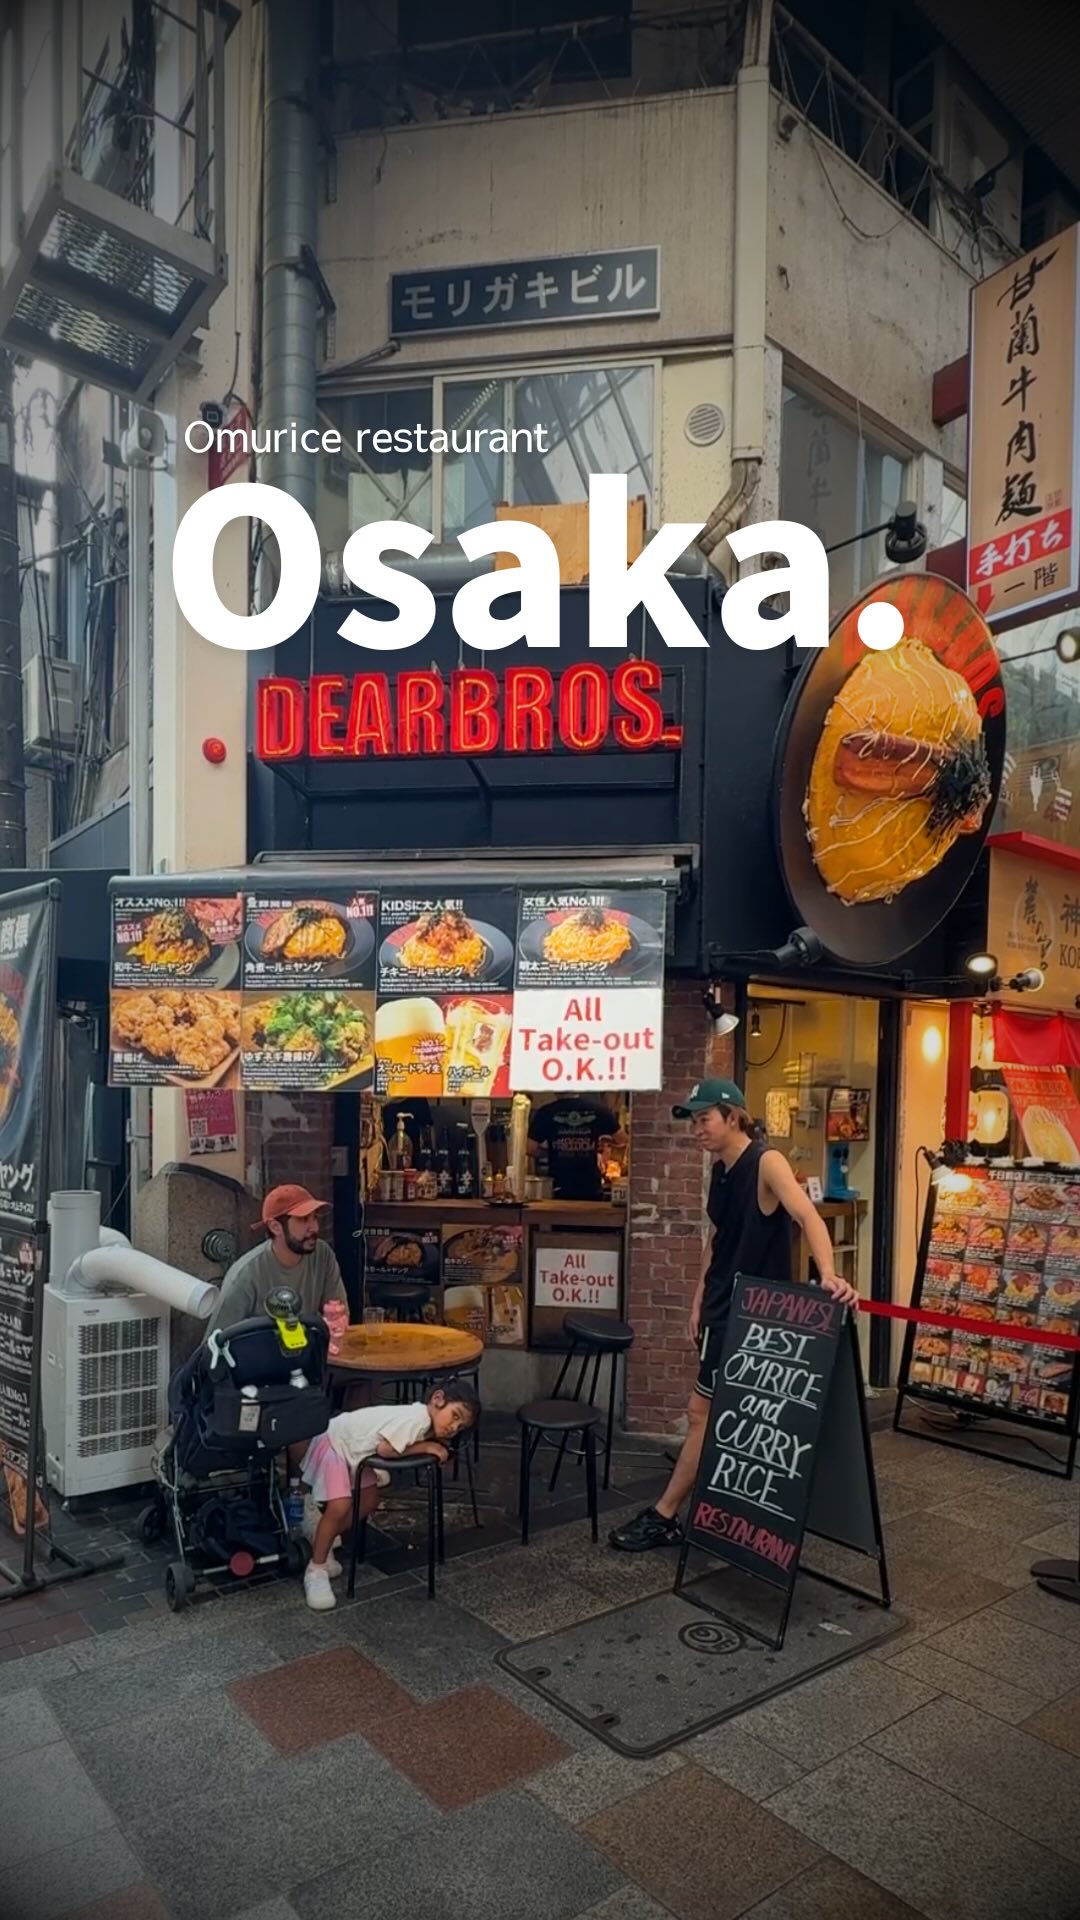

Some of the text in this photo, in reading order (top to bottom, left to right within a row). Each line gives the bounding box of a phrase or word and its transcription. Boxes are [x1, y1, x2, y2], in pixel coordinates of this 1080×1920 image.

[401, 264, 647, 320] モリガキビル
[975, 519, 1063, 577] 手打ち
[1003, 562, 1058, 592] 一階
[381, 899, 463, 911] KIDSに大人気!!
[563, 997, 602, 1022] All
[519, 1027, 655, 1051] Take-out
[542, 1056, 627, 1081] O.K.!!
[564, 1253, 586, 1269] All
[539, 1269, 615, 1287] Take-out
[552, 1287, 600, 1304] O.K.!!
[741, 1323, 817, 1360] BEST
[724, 1352, 824, 1407] OMRICE
[739, 1394, 788, 1424] and
[715, 1409, 812, 1480] CURRY
[710, 1453, 786, 1511] RICE
